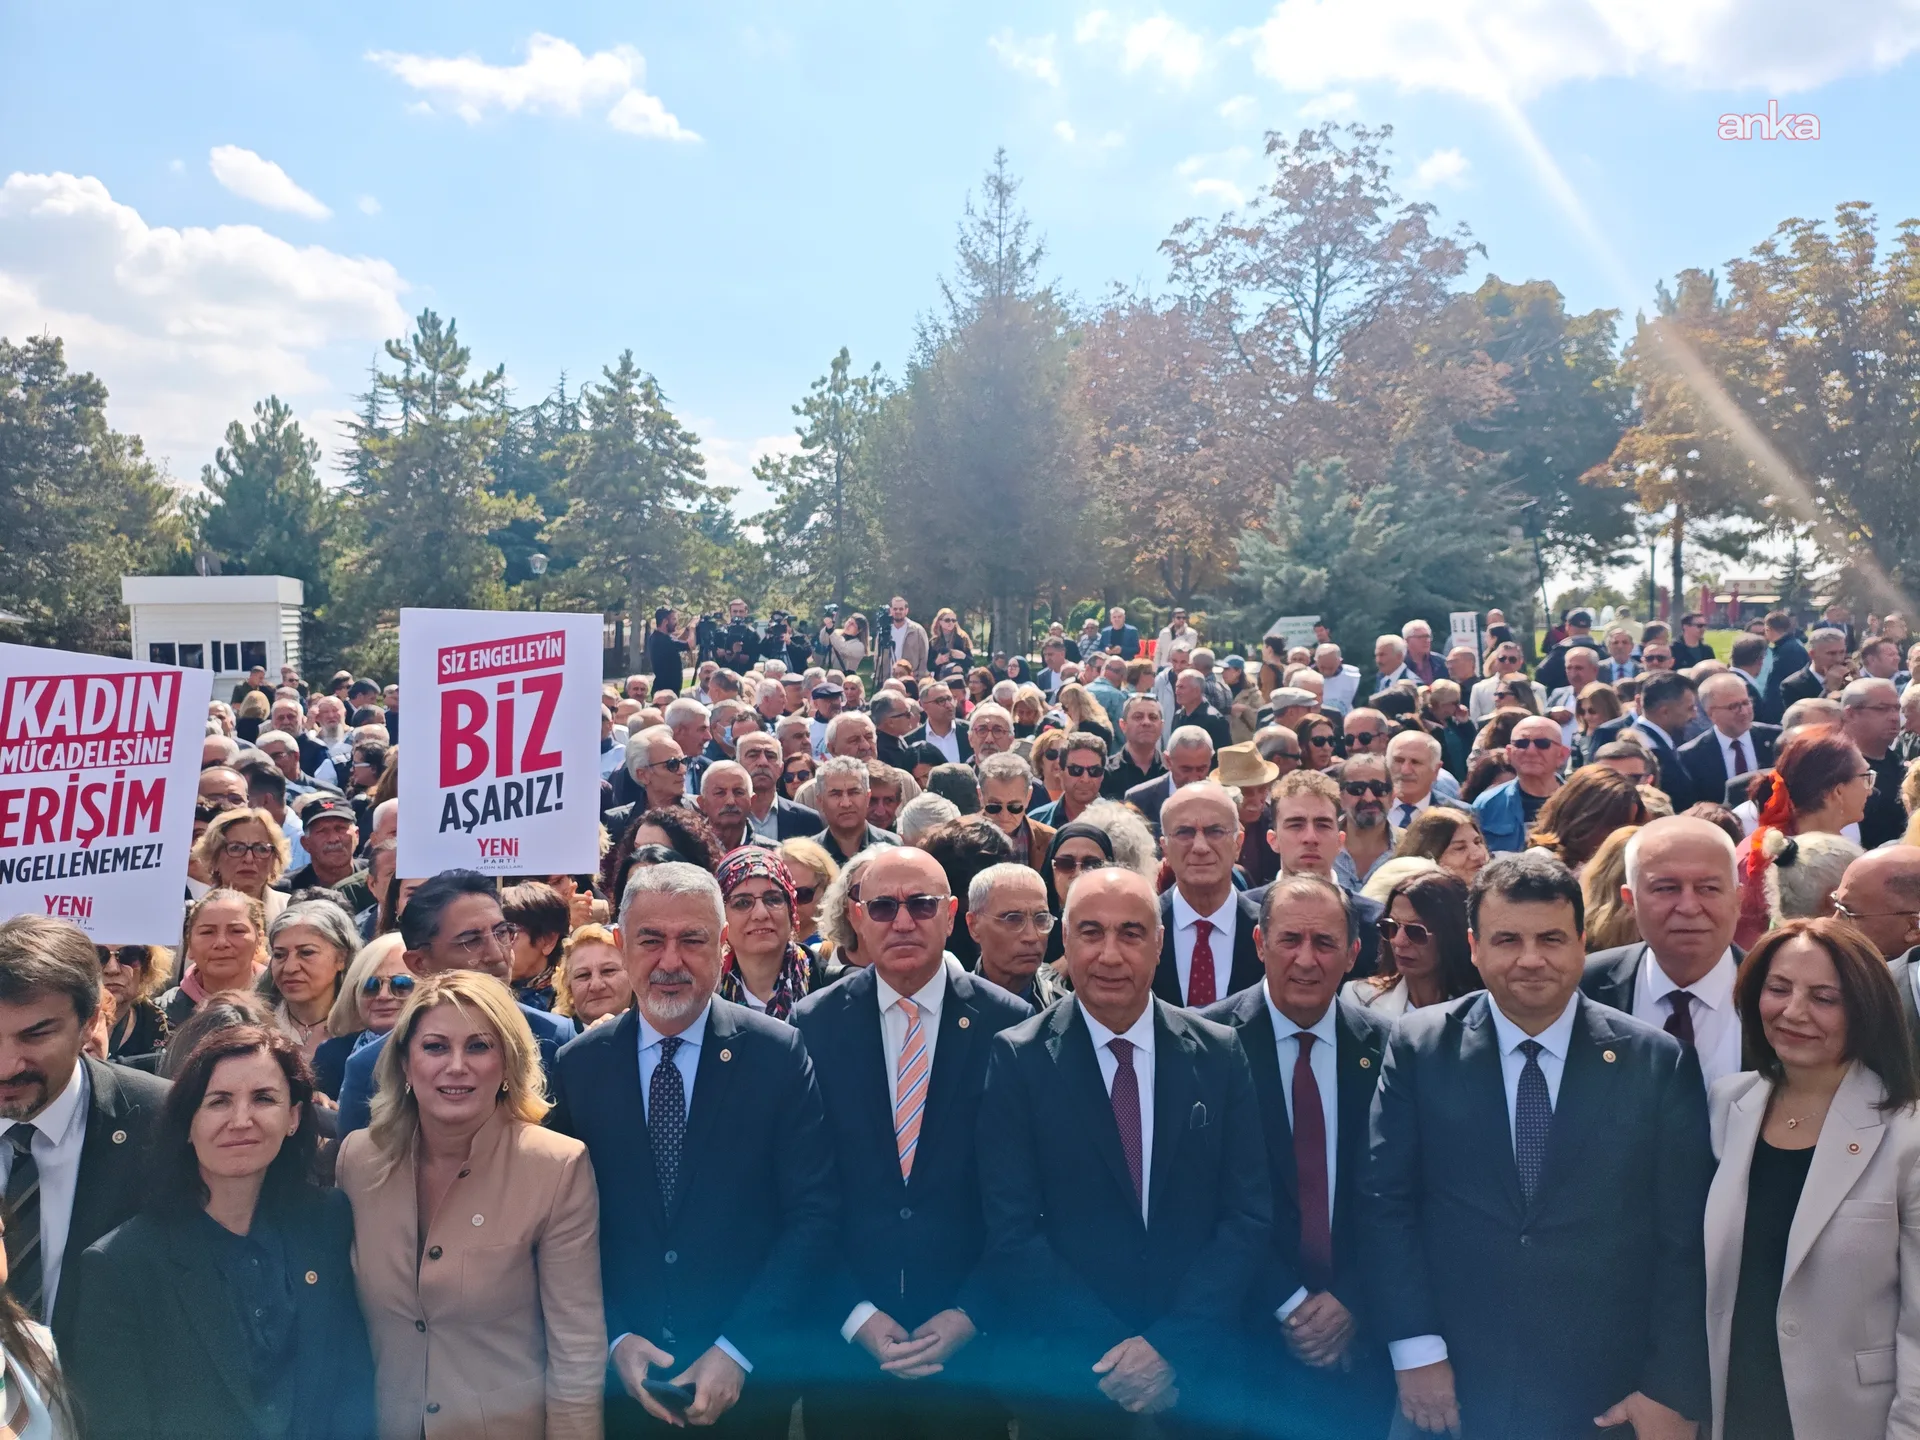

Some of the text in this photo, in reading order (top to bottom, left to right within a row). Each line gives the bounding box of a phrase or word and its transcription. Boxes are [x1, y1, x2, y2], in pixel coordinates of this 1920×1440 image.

[441, 635, 563, 675] SİZ ENGELLEYİN
[6, 675, 173, 740] KADIN
[0, 733, 171, 773] MÜCADELESİNE
[0, 769, 167, 848] ERİŞİM
[438, 772, 563, 834] AŞARIZ!
[0, 843, 163, 885] NGELLENEMEZ!
